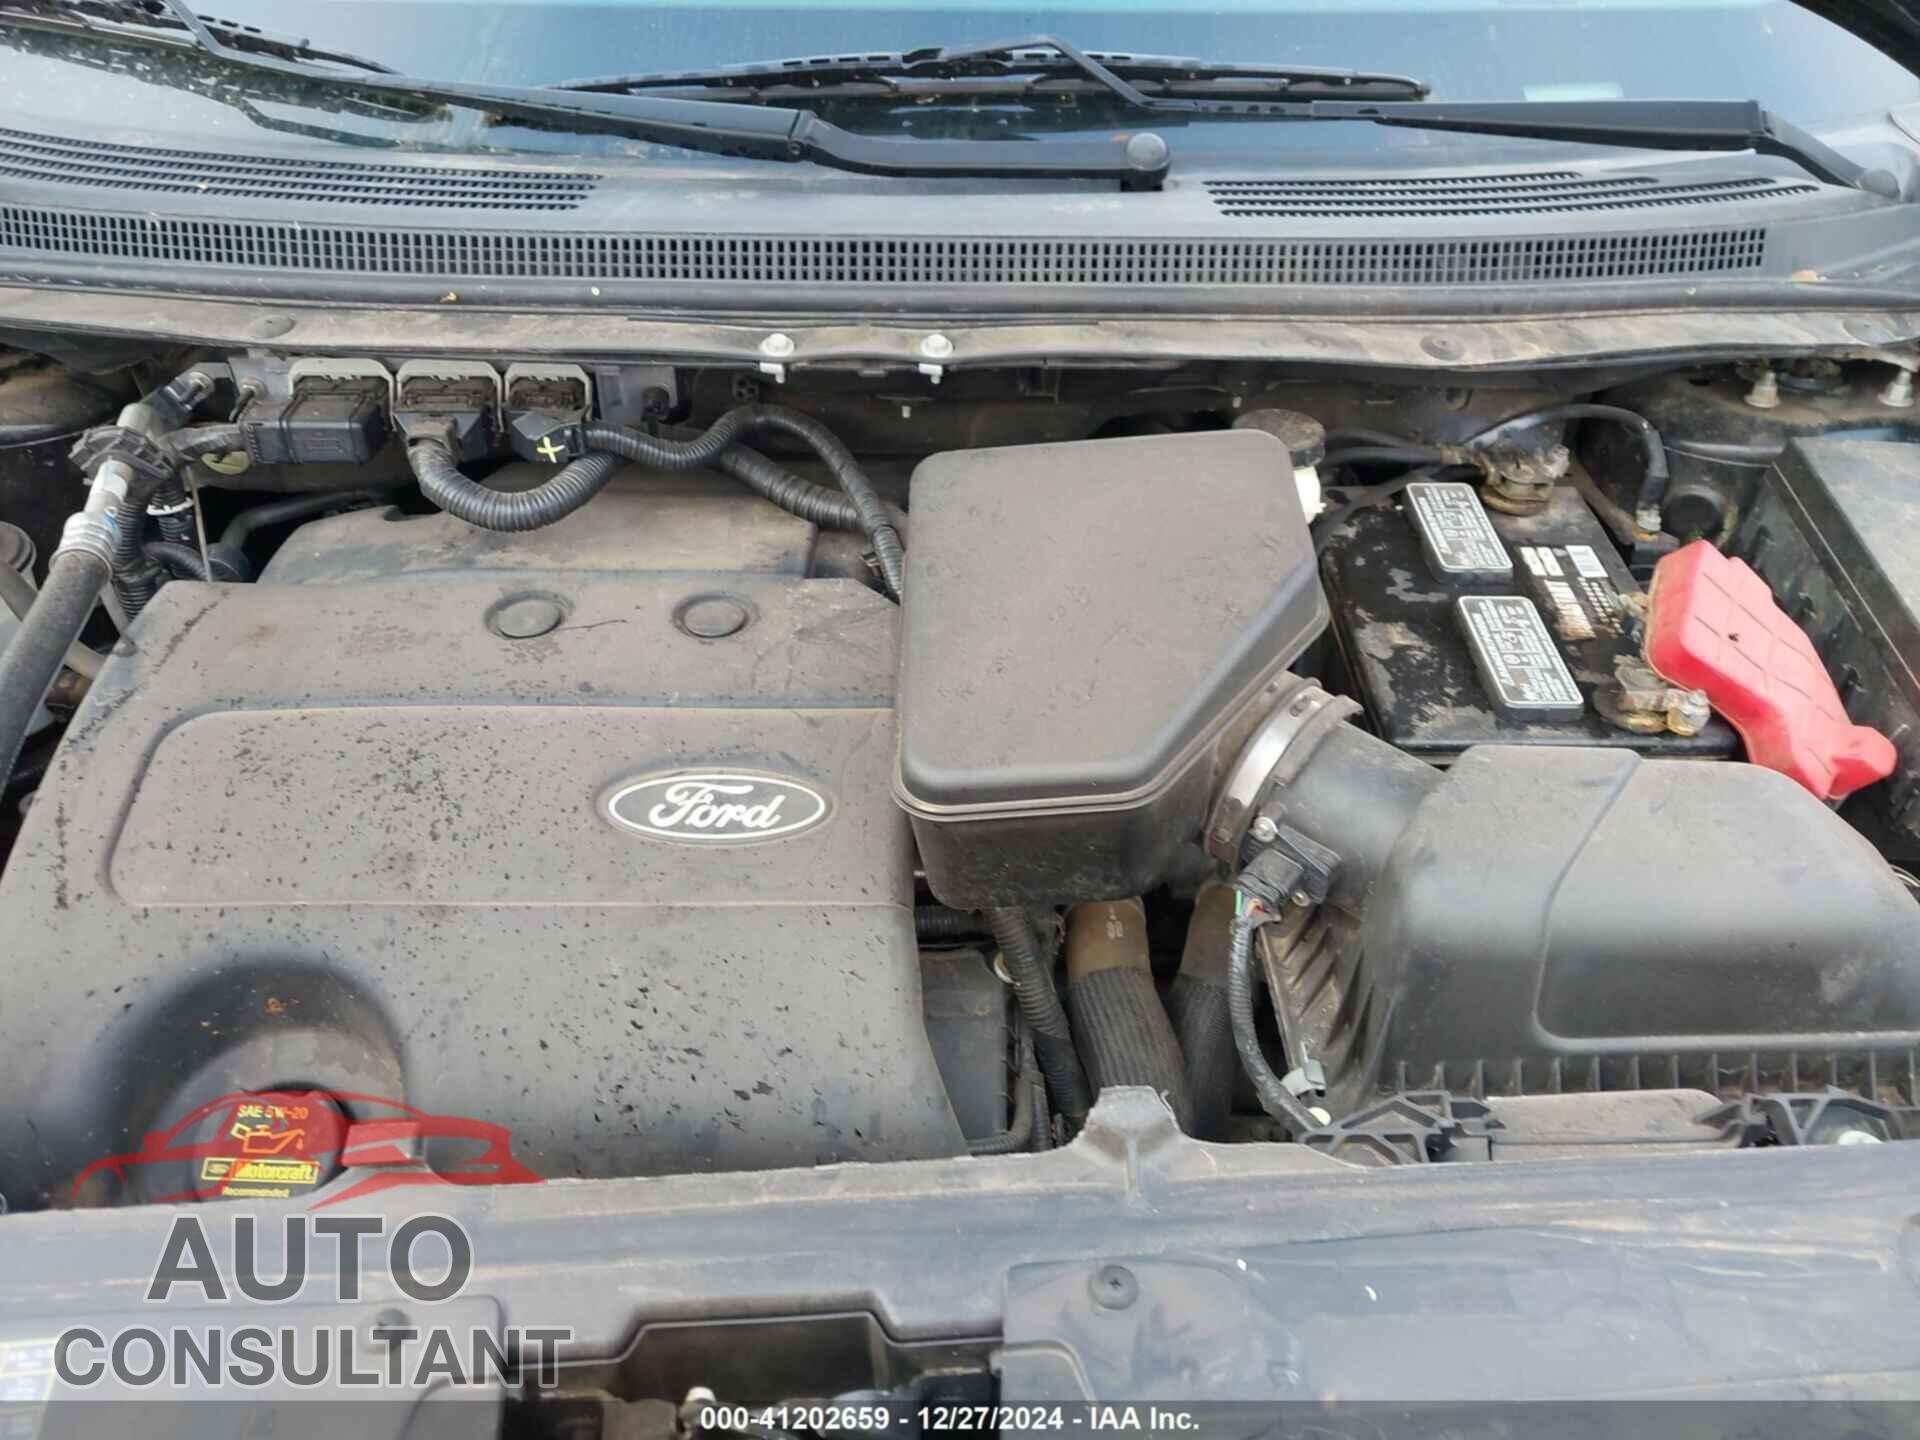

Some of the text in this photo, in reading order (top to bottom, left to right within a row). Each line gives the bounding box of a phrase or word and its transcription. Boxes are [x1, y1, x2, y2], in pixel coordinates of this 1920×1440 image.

[648, 782, 787, 828] Ford
[238, 1104, 309, 1120] SAE 5W-20
[233, 1161, 314, 1181] Motorcraft
